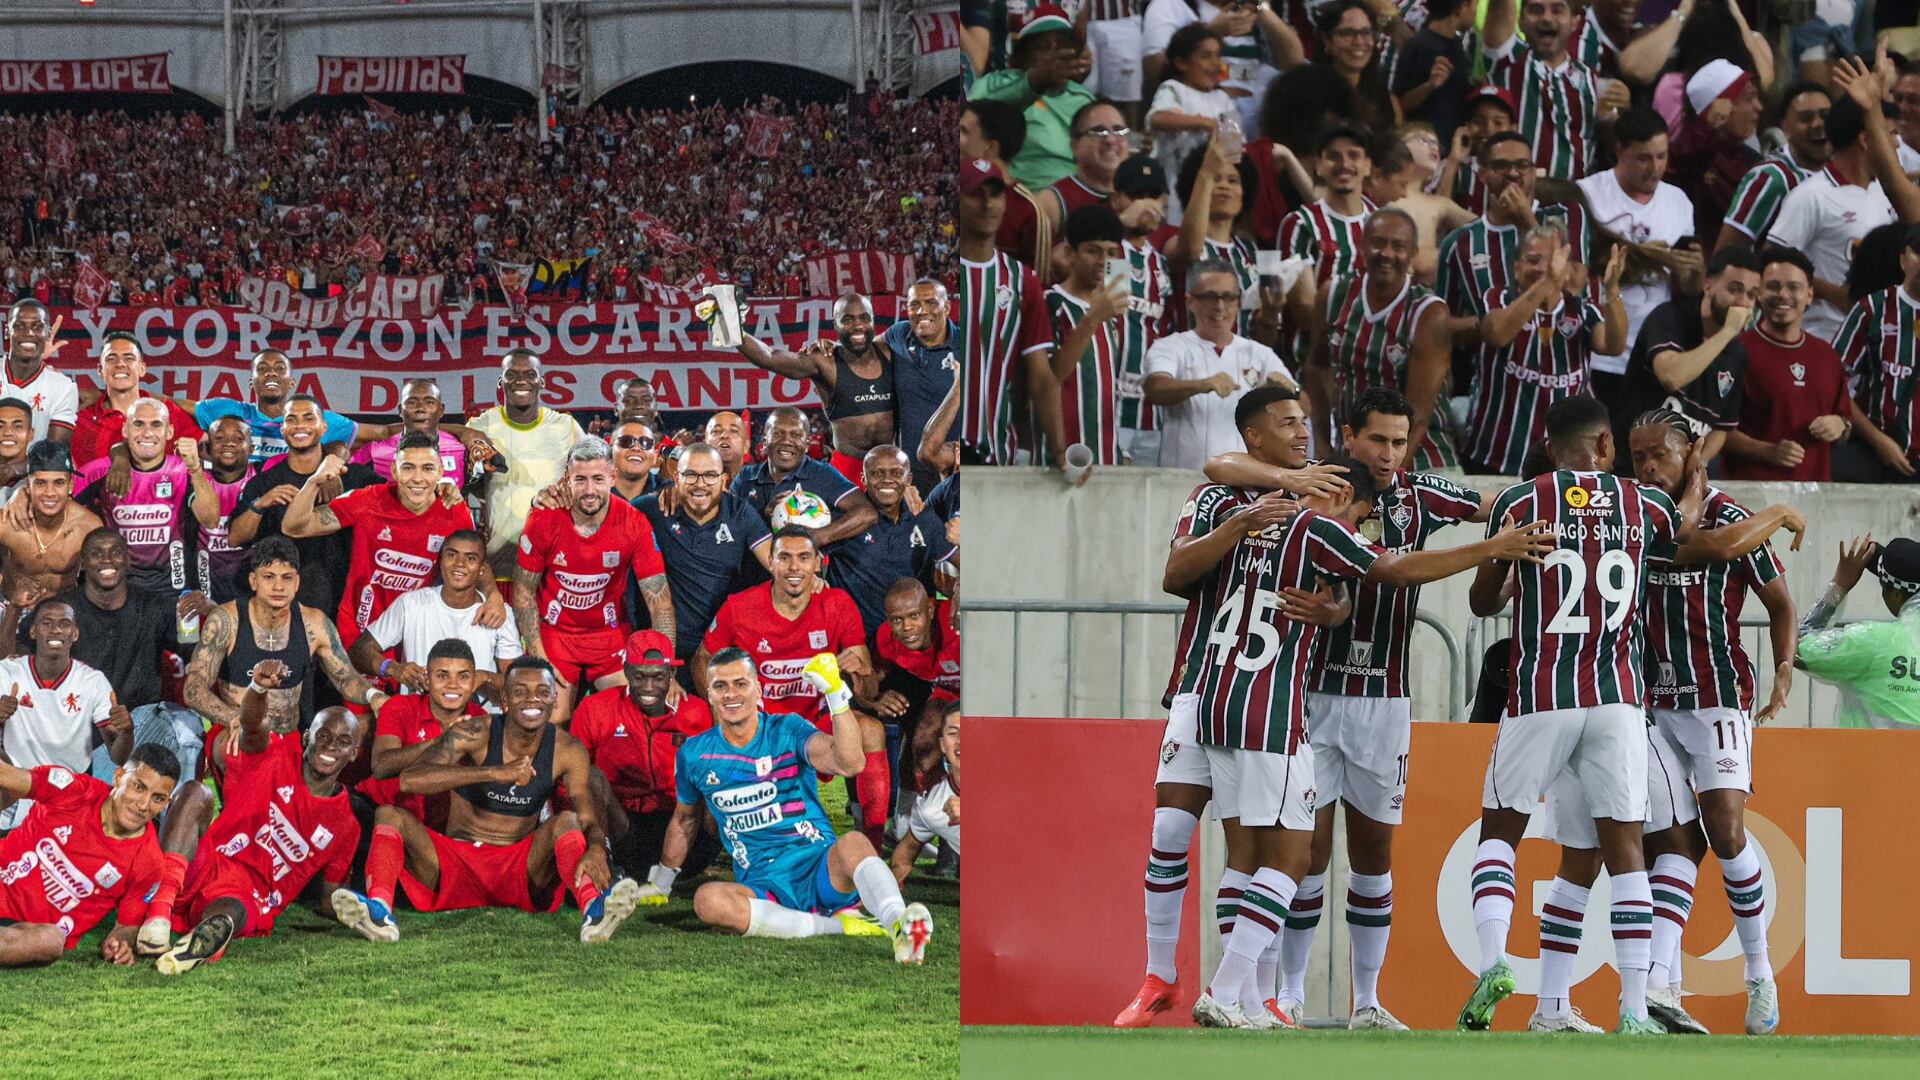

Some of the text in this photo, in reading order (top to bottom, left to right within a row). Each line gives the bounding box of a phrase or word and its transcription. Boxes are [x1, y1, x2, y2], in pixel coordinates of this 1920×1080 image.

[72, 55, 169, 91] LOPEZ
[73, 309, 115, 357] Y
[1505, 361, 1583, 389] SUPERBET
[854, 393, 891, 402] CATAPULT
[113, 508, 170, 521] Colanta
[1569, 508, 1614, 517] DELIVERY
[1244, 537, 1279, 550] DELIVERY
[1593, 523, 1644, 543] SANTOS
[172, 545, 184, 585] BetPlay
[377, 551, 430, 572] Colanta
[1239, 553, 1273, 576] LIMA
[374, 573, 419, 592] AGUILA
[556, 573, 608, 589] Colanta
[1544, 548, 1636, 634] 29
[561, 592, 601, 608] AGUILA
[1207, 584, 1287, 673] 45
[767, 683, 813, 698] AGUILA
[1713, 720, 1737, 750] 11
[487, 791, 532, 805] CATAPULT
[713, 785, 774, 809] Colanta
[40, 840, 88, 895] Colanta
